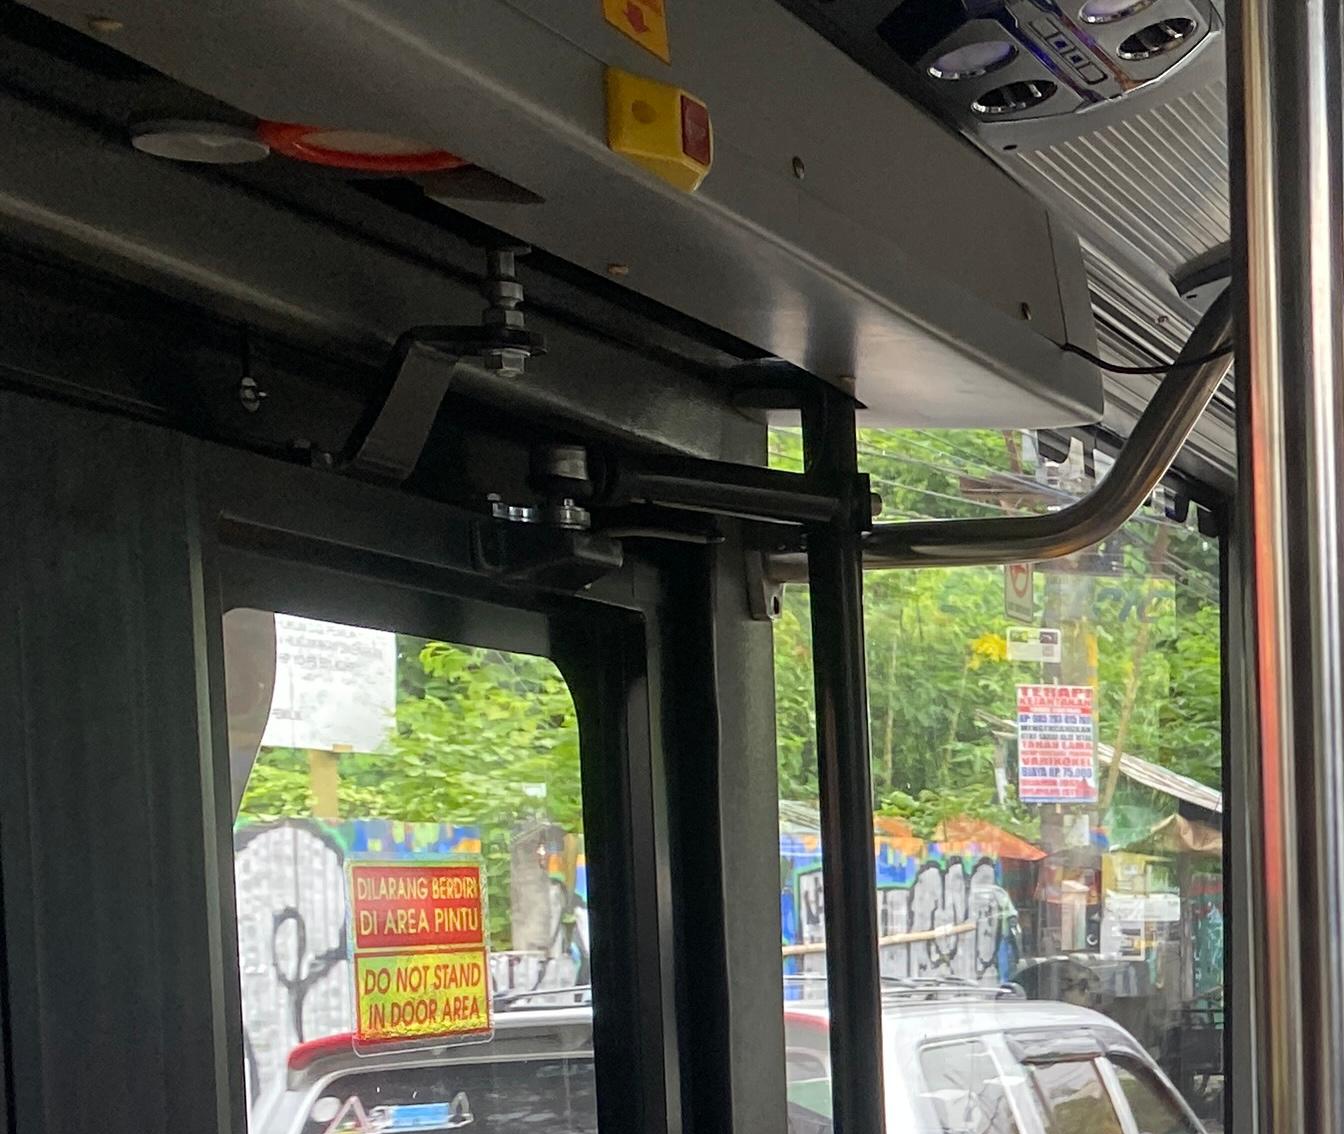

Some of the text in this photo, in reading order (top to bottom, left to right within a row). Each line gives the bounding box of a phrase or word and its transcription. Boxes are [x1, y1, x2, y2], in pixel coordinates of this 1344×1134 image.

[357, 876, 478, 901] DILARANG BERDIRI
[360, 907, 478, 936] DI AREA PINTU
[365, 962, 481, 996] DO NOT STAND
[369, 994, 480, 1030] IN DOOR AREA
